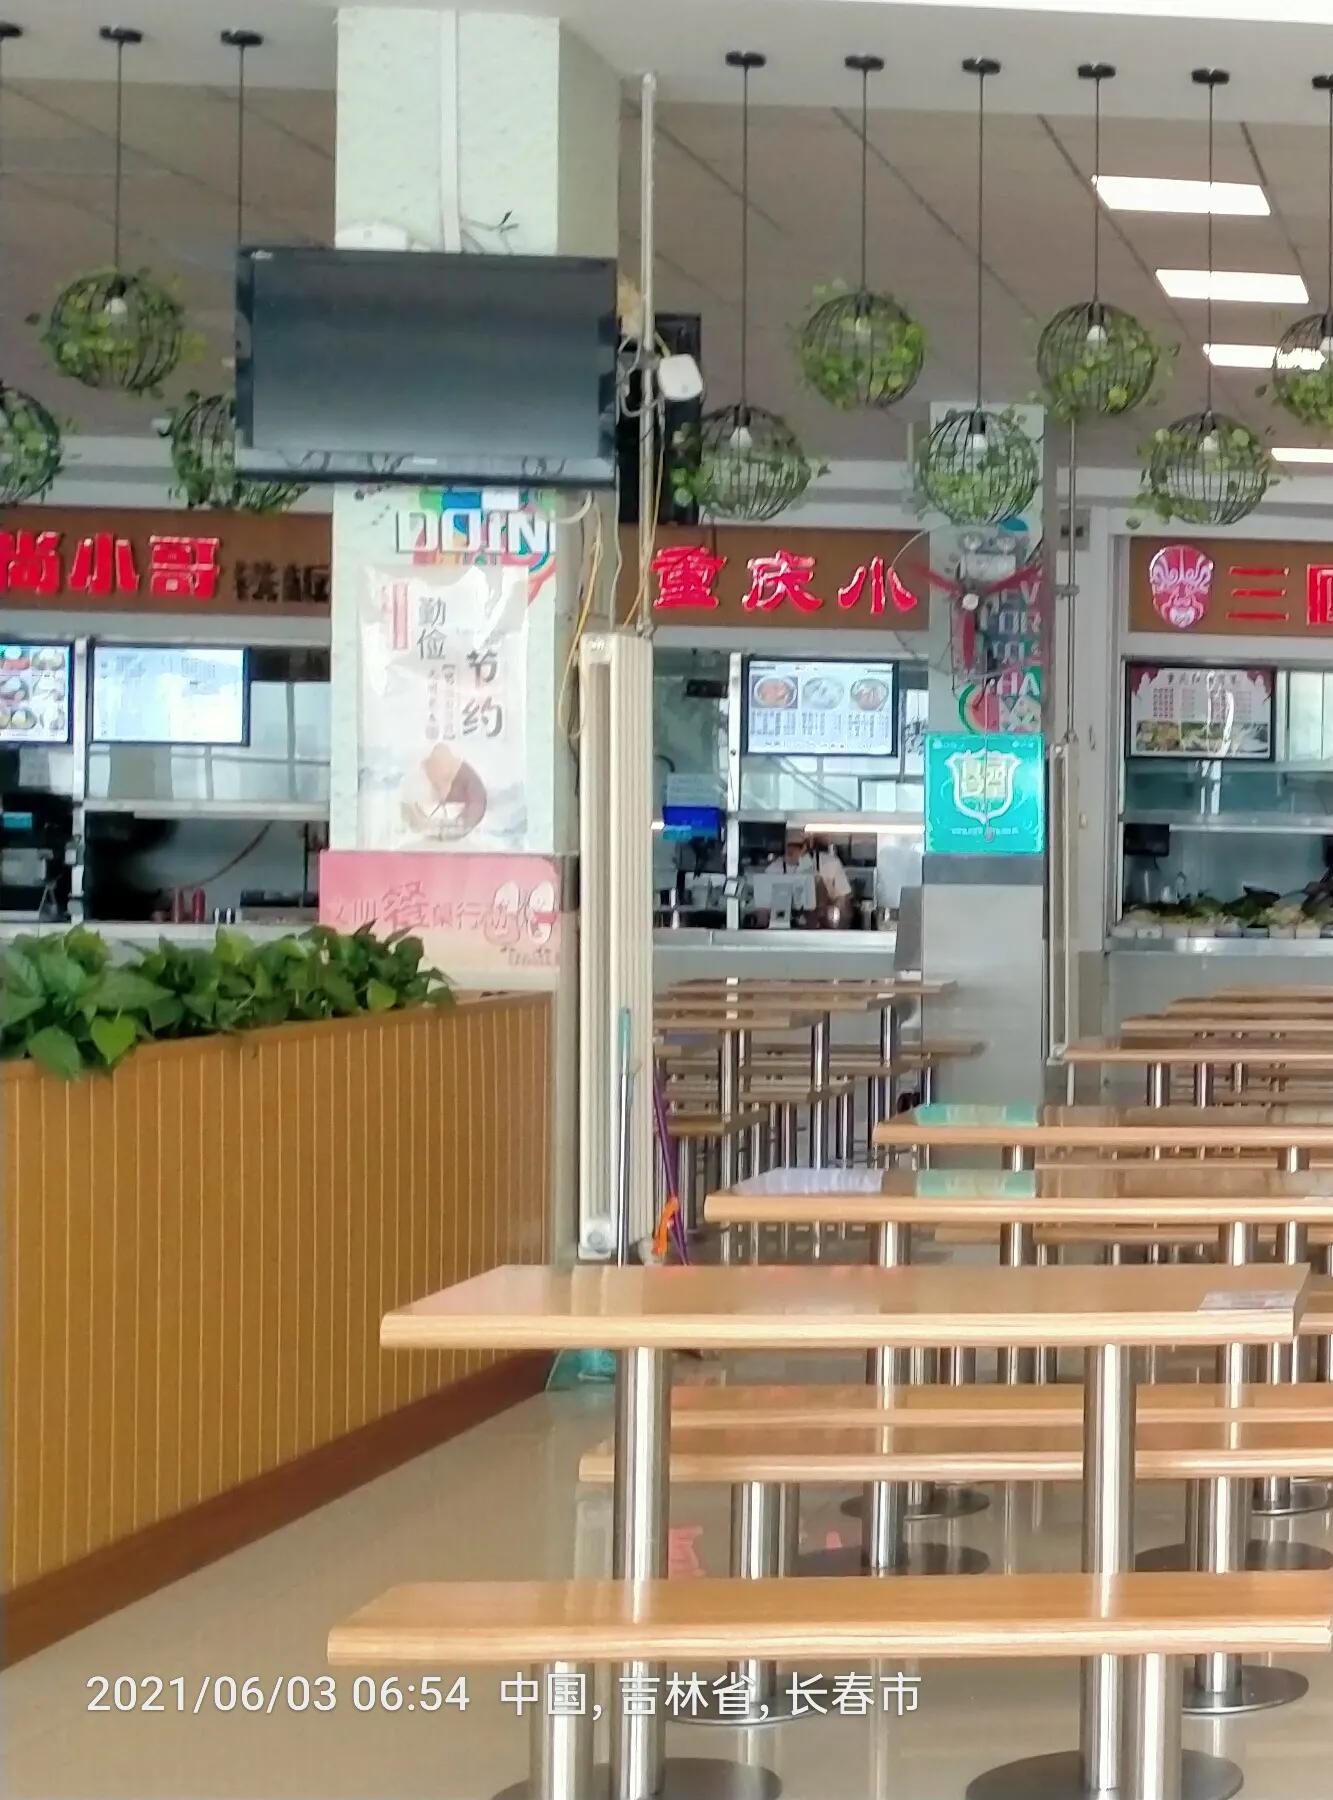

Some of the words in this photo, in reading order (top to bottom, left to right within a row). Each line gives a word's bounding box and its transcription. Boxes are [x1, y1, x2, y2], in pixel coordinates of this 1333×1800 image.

[651, 545, 919, 615] 重庆小
[461, 649, 504, 738] 节约
